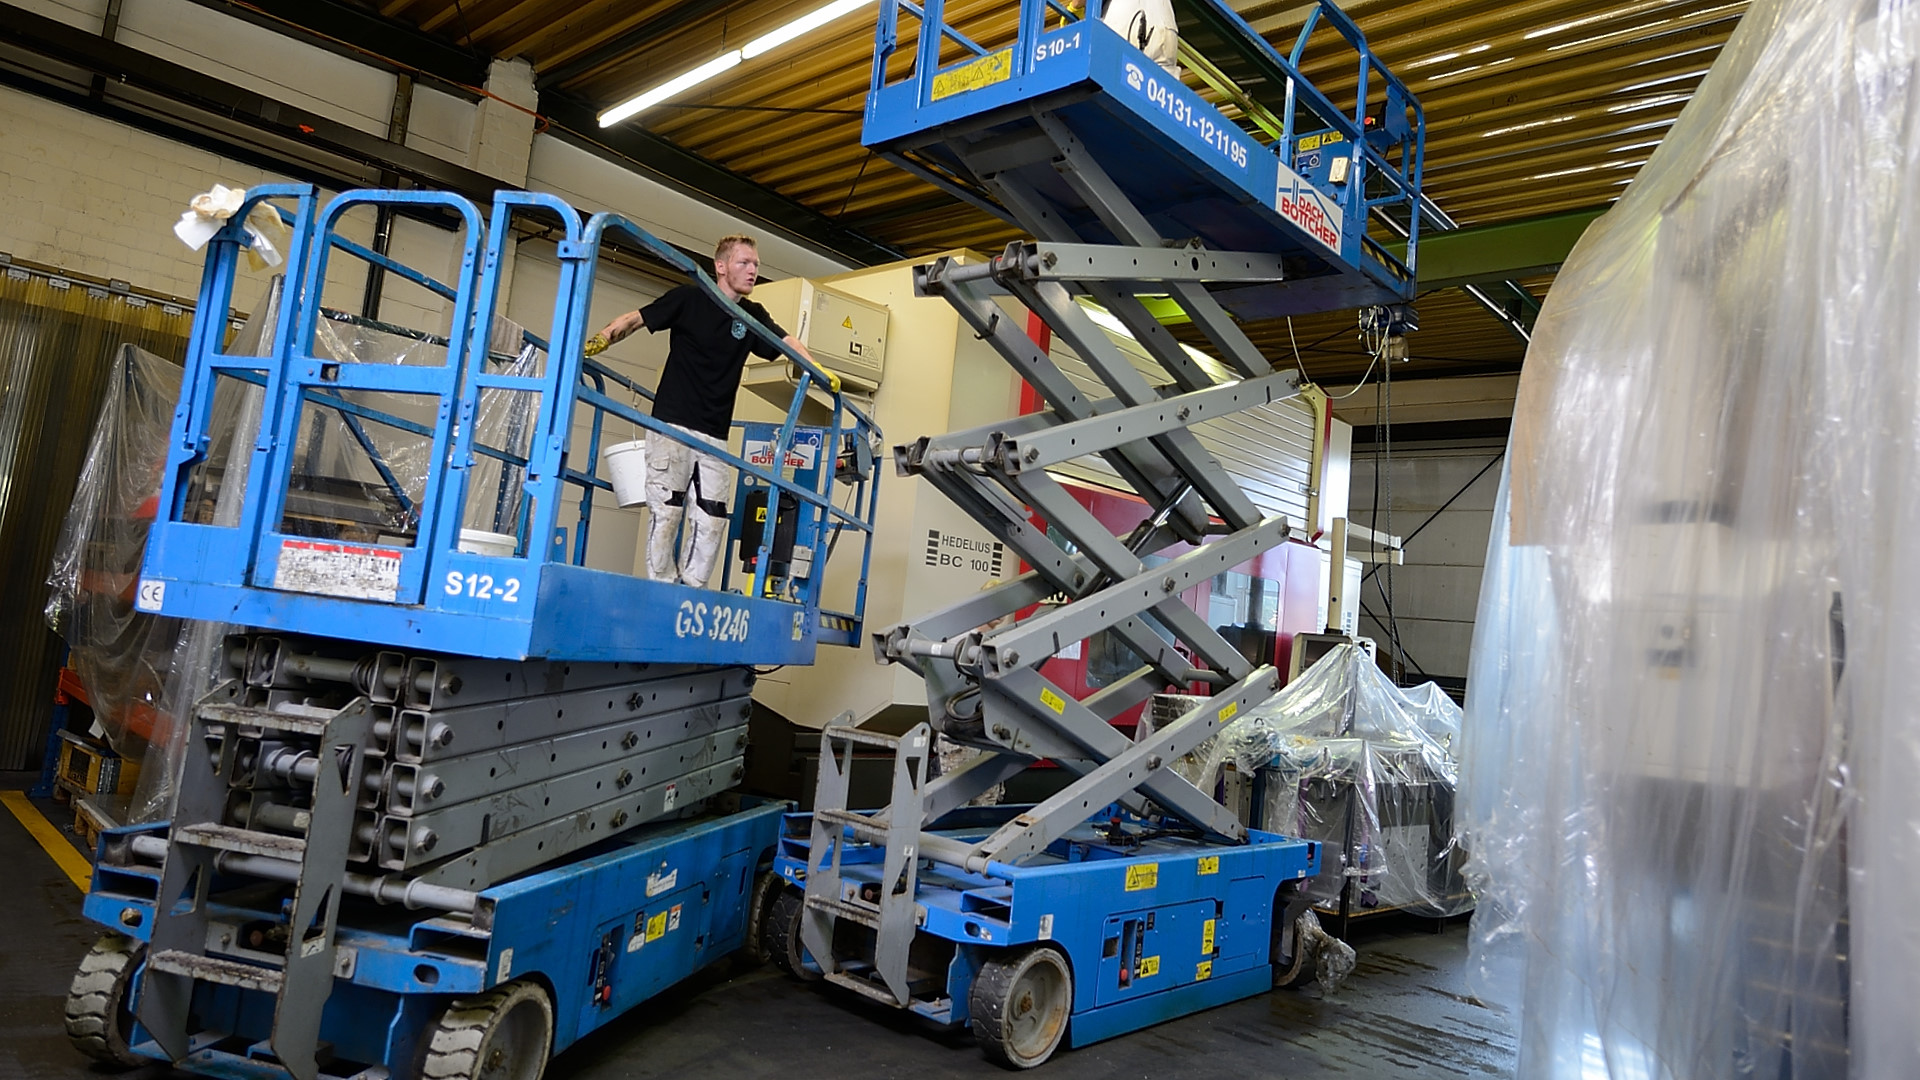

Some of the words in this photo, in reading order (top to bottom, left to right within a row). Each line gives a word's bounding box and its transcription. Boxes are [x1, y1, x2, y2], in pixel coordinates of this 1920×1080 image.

[1035, 32, 1081, 62] S10-1
[1298, 196, 1324, 223] DACH
[942, 535, 991, 554] HEDELIUS
[940, 553, 963, 568] BC
[970, 559, 989, 572] 100
[141, 585, 162, 602] CE
[444, 571, 520, 603] S12-2
[676, 600, 708, 638] GS
[708, 605, 750, 642] 3246
